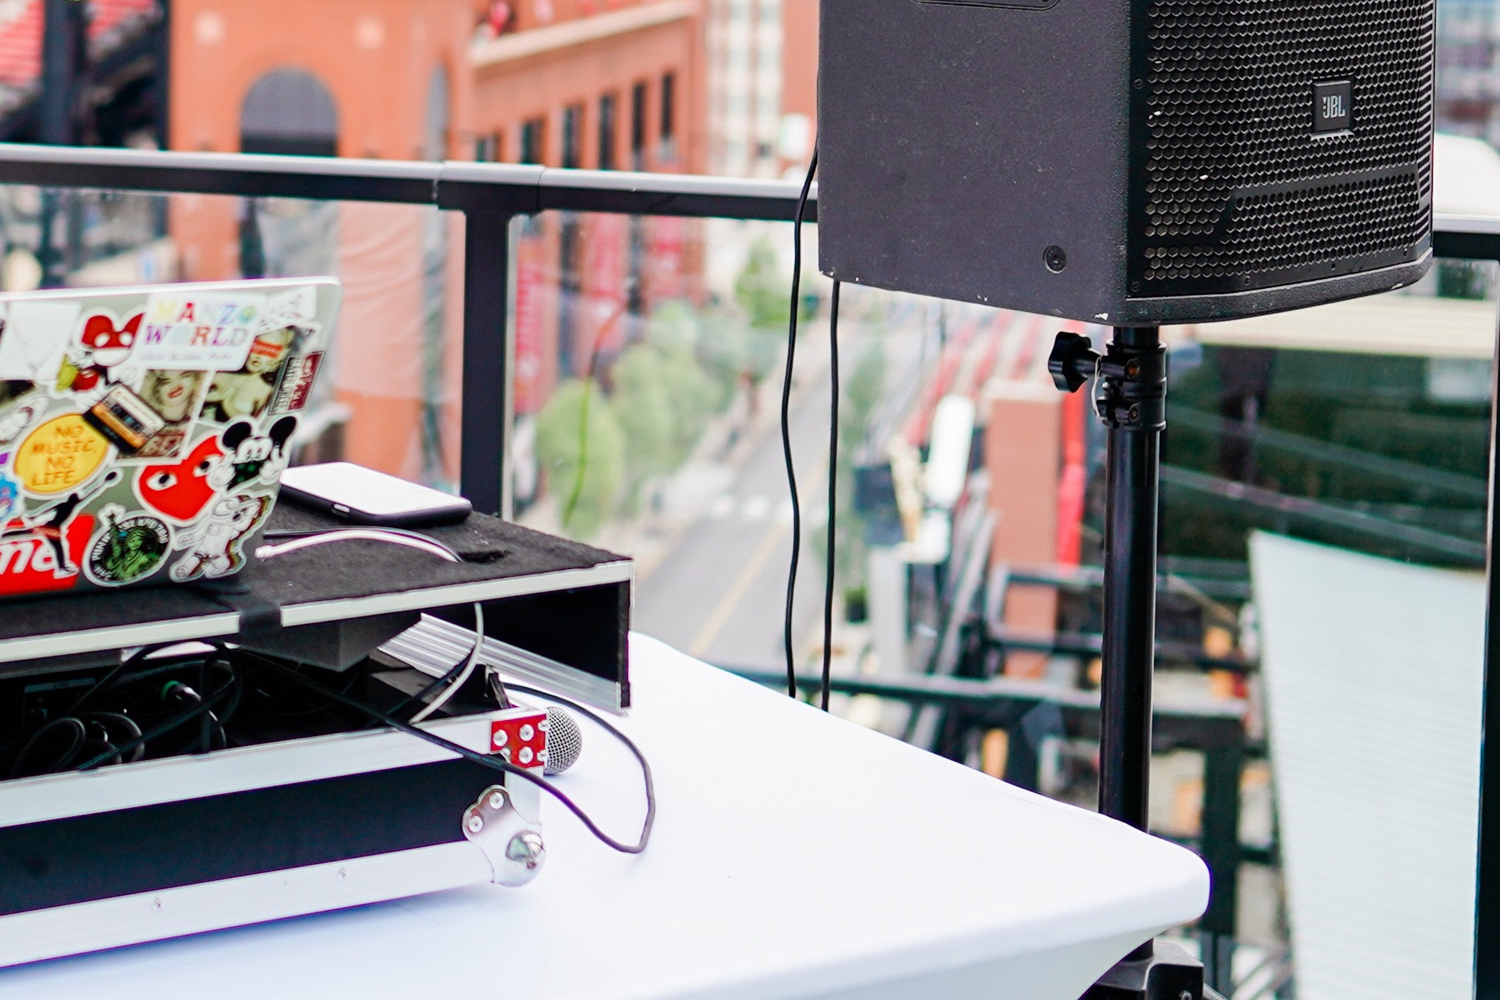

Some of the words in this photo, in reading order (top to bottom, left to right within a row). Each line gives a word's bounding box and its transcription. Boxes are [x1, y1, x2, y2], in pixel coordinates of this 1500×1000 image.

[1323, 95, 1345, 118] JBL
[145, 325, 248, 346] WORLD
[55, 425, 84, 438] NO
[46, 456, 75, 469] NO
